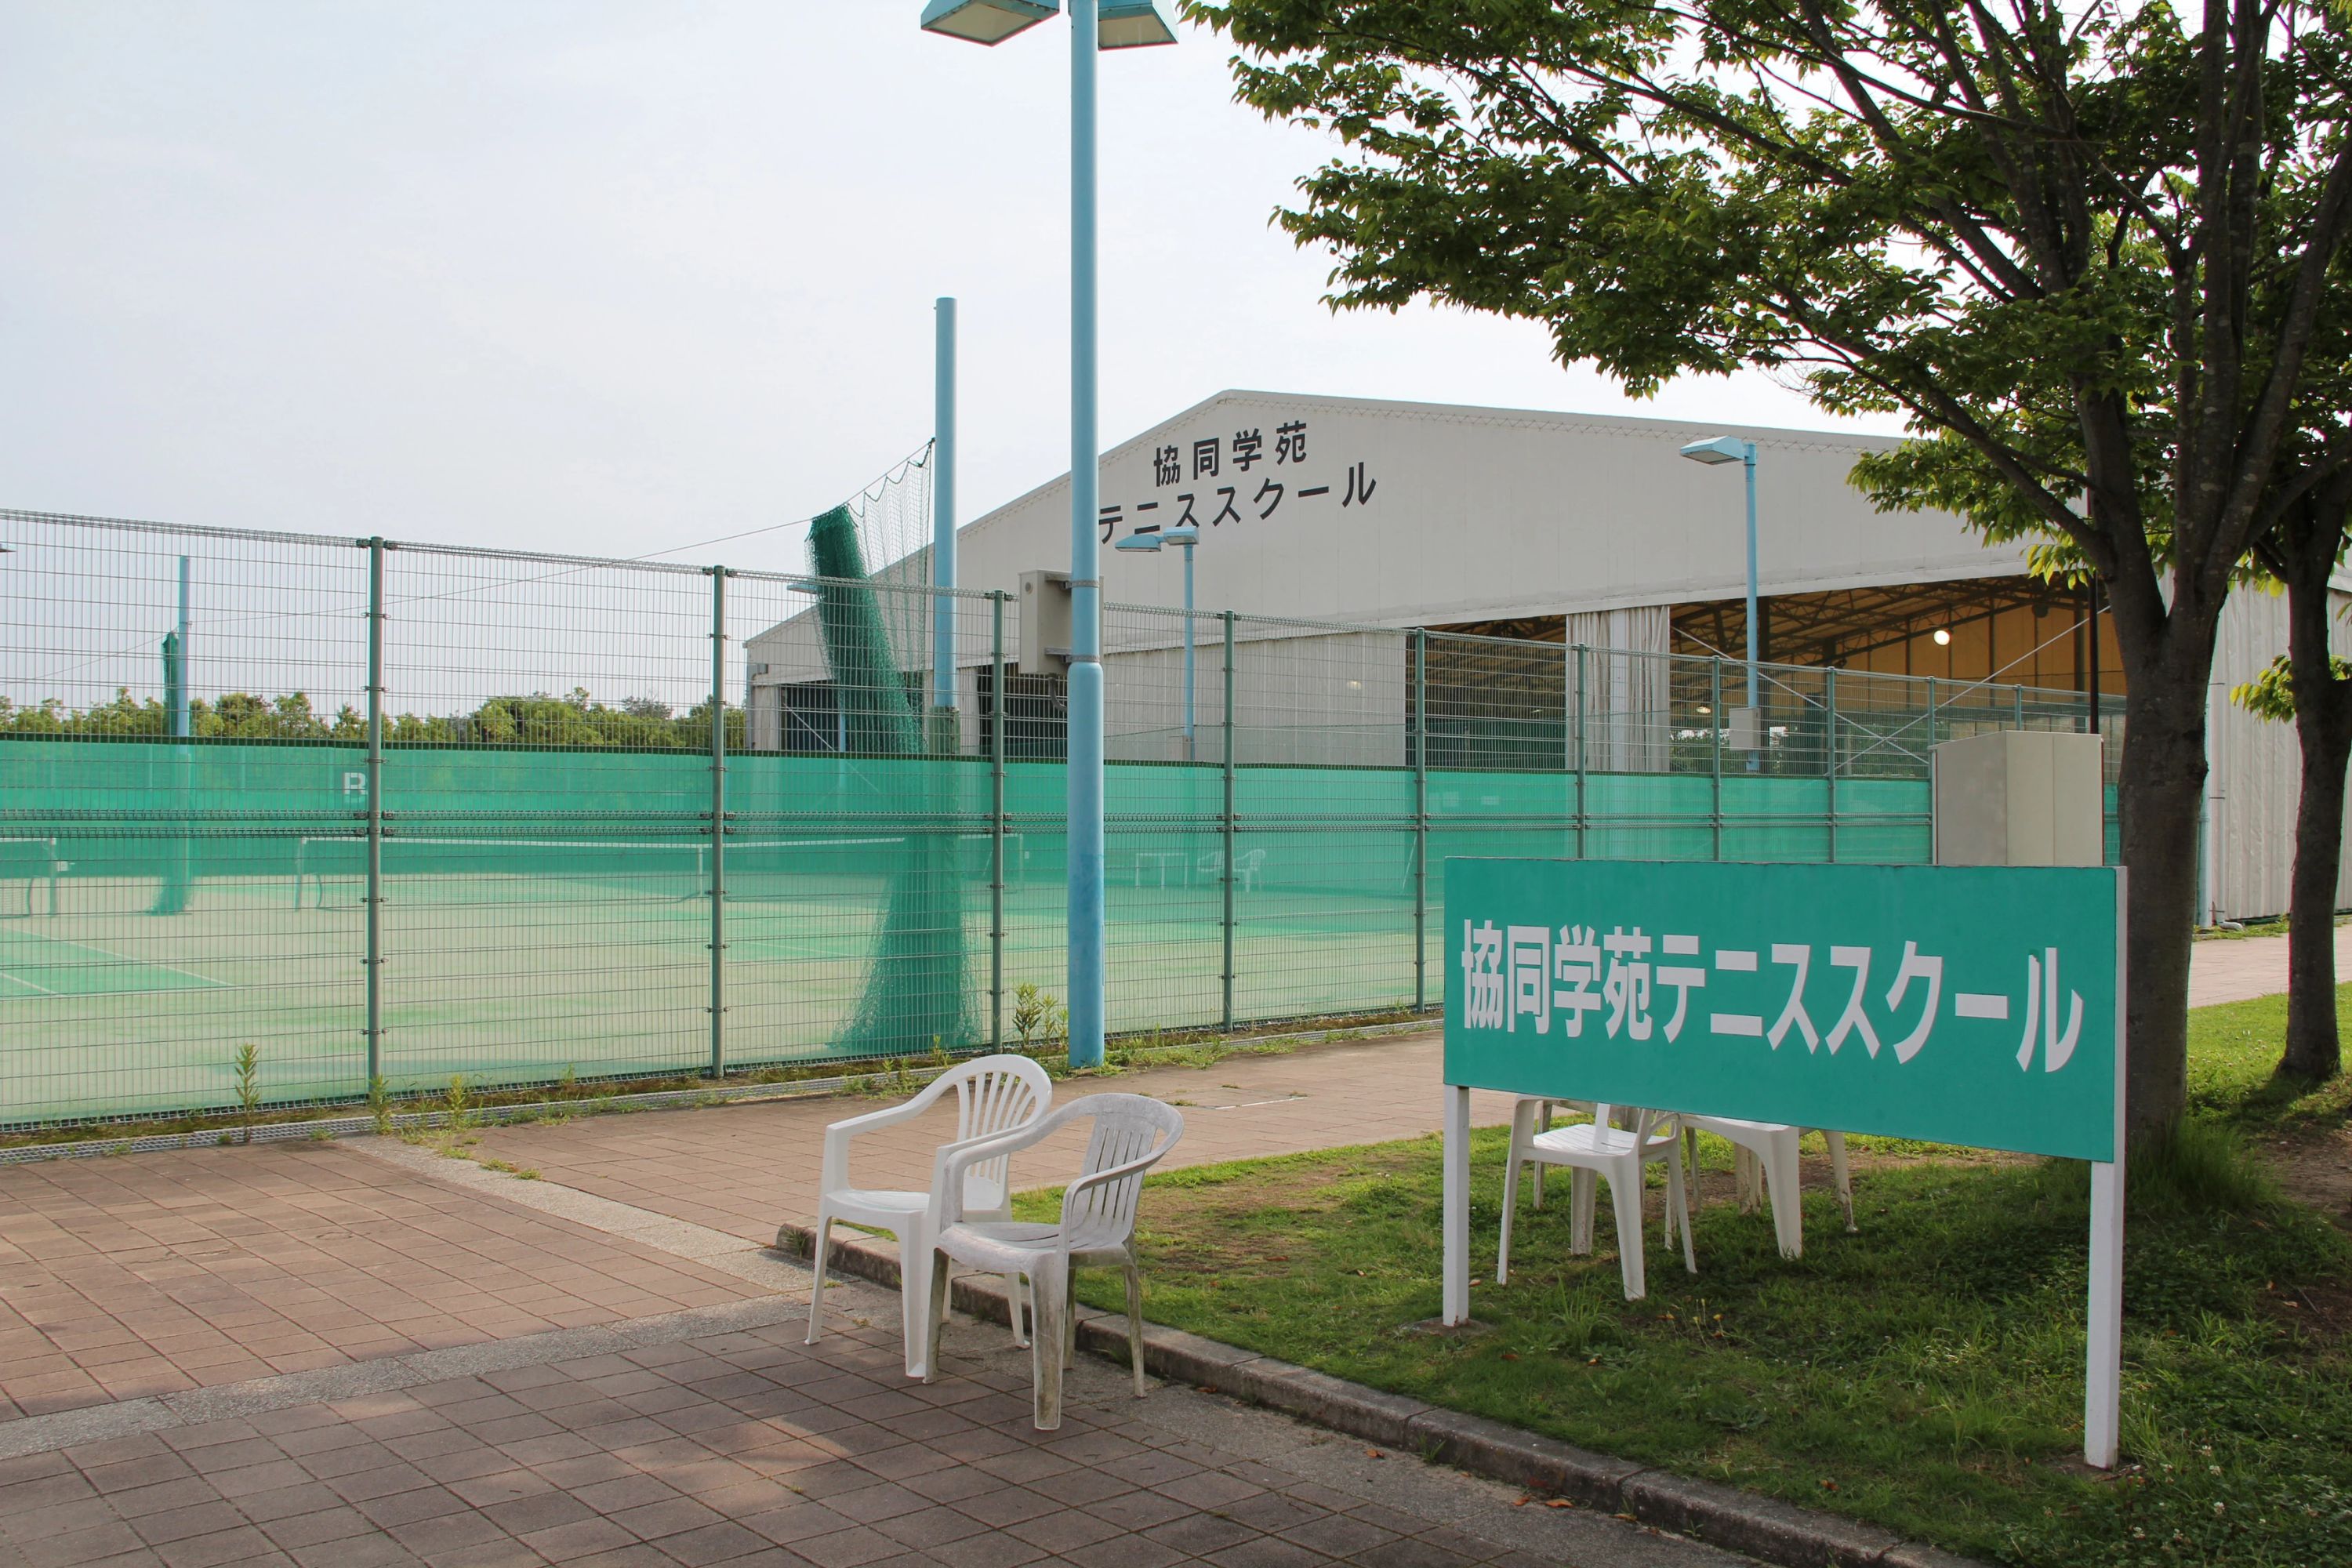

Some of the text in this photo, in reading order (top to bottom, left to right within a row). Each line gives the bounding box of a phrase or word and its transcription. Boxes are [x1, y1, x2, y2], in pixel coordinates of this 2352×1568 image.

[1153, 420, 1307, 488] 協同学苑
[1098, 461, 1377, 545] テニススクール
[1461, 918, 2084, 1073] 協同学苑テニススクール
